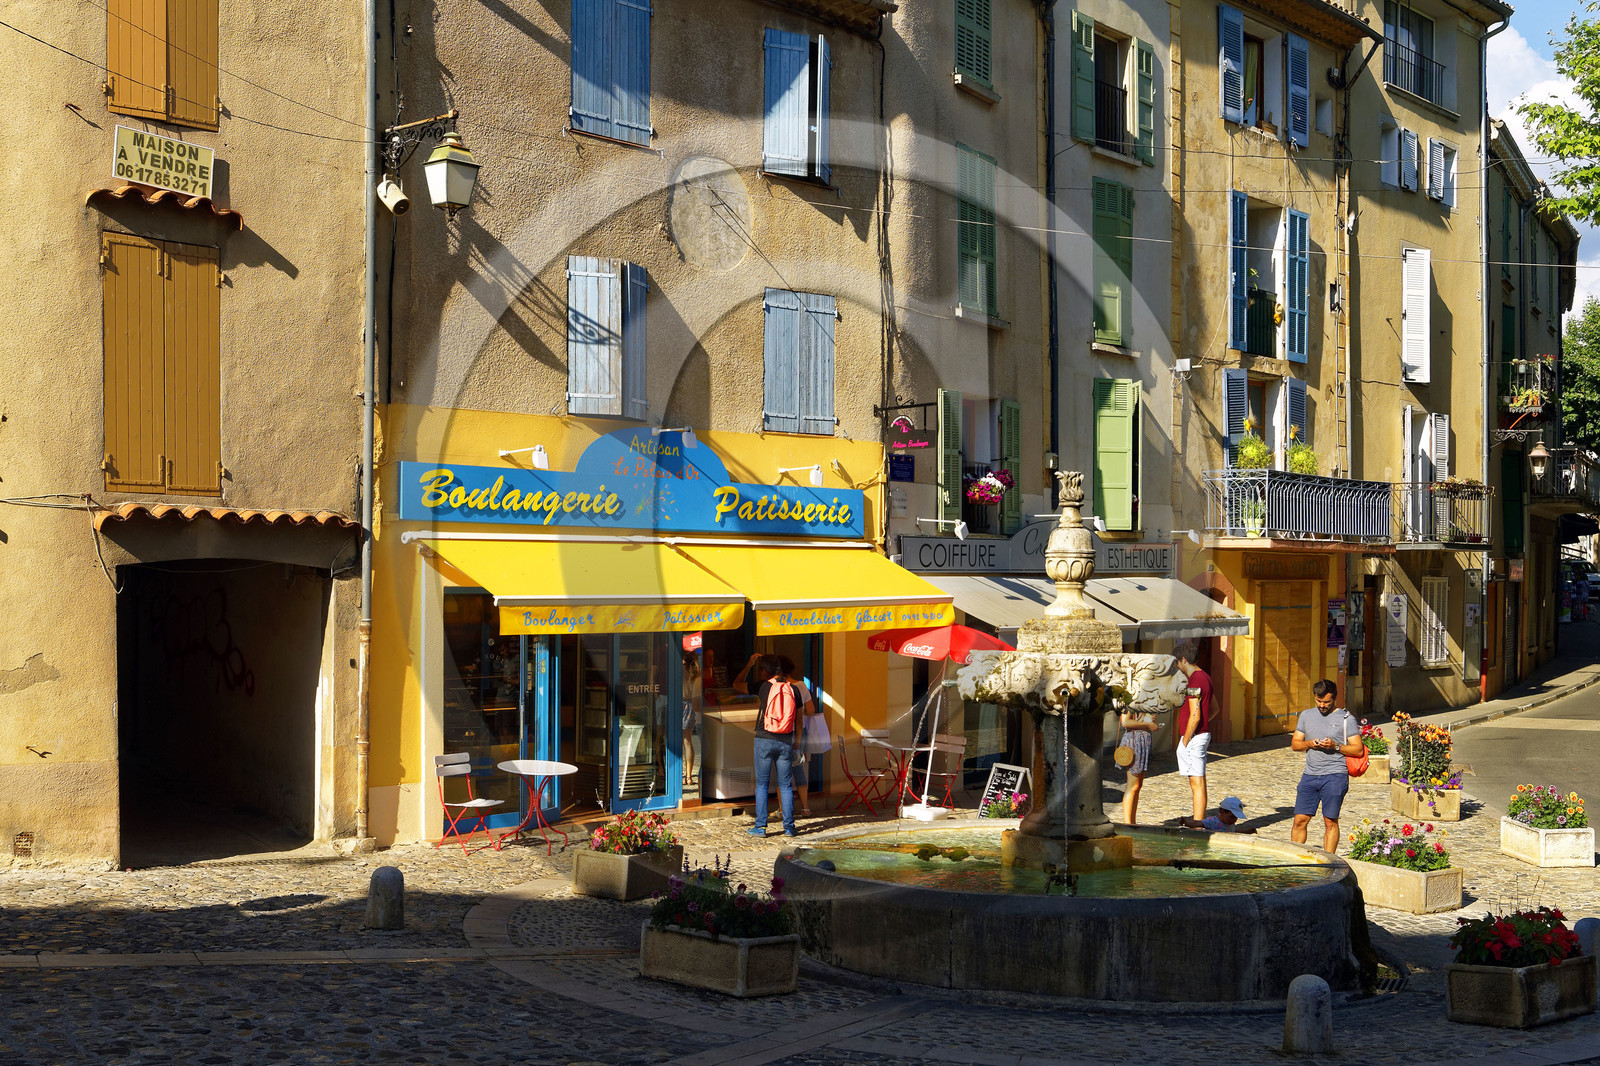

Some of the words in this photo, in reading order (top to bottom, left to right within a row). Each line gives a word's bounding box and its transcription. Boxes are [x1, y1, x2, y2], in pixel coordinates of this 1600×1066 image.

[133, 132, 199, 161] MAISON
[117, 146, 128, 160] À
[138, 150, 209, 180] VENDRE
[629, 434, 680, 457] Artisan
[611, 456, 629, 476] Le
[633, 456, 672, 479] Palais
[418, 467, 620, 526] Boulangerie
[713, 486, 852, 525] Patisserie
[919, 543, 996, 569] COIFFURE
[1108, 543, 1168, 569] ESTHÉTIQUE
[522, 609, 596, 633] Boulanger
[662, 609, 724, 631] Pâtissier
[779, 612, 844, 627] Chocolatier
[855, 609, 893, 630] Glacier
[628, 680, 660, 694] ENTRÉE
